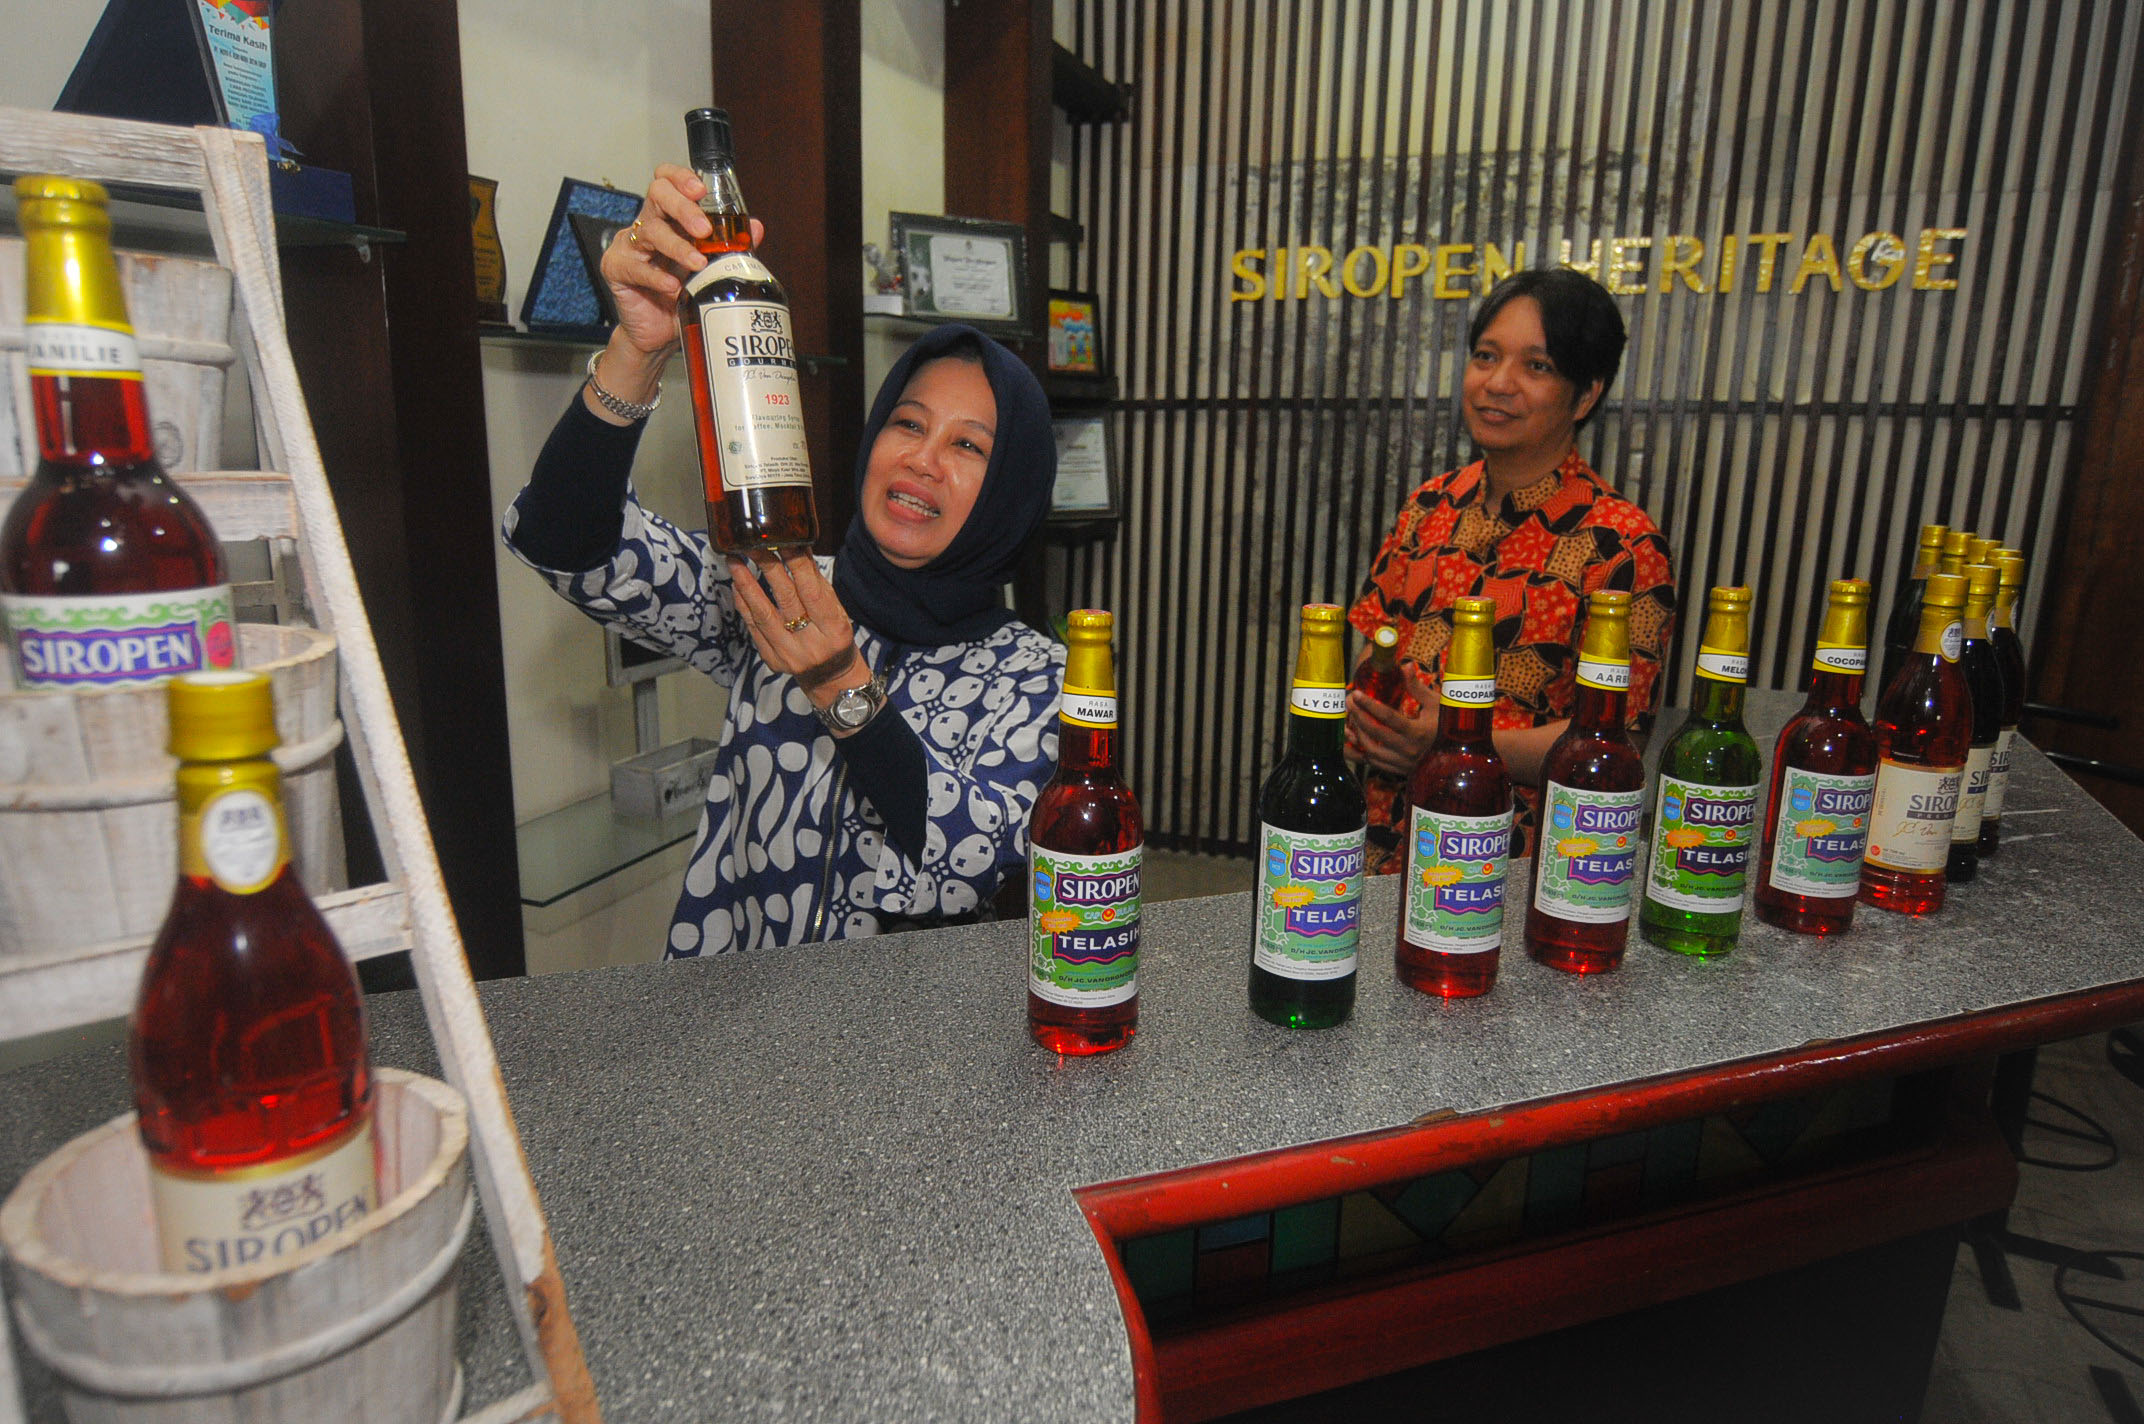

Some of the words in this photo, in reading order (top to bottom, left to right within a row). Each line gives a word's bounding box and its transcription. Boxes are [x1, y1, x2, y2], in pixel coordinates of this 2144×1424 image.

[208, 24, 241, 43] Terima
[243, 36, 268, 52] Kasih
[1231, 241, 1525, 302] SIROPEN
[1559, 228, 1968, 295] HERITAGE
[725, 335, 793, 359] SIROPE
[765, 393, 790, 406] 1923
[21, 632, 194, 675] SIROPEN
[1077, 707, 1114, 719] MAWAR
[1062, 871, 1140, 900] SIROPEN
